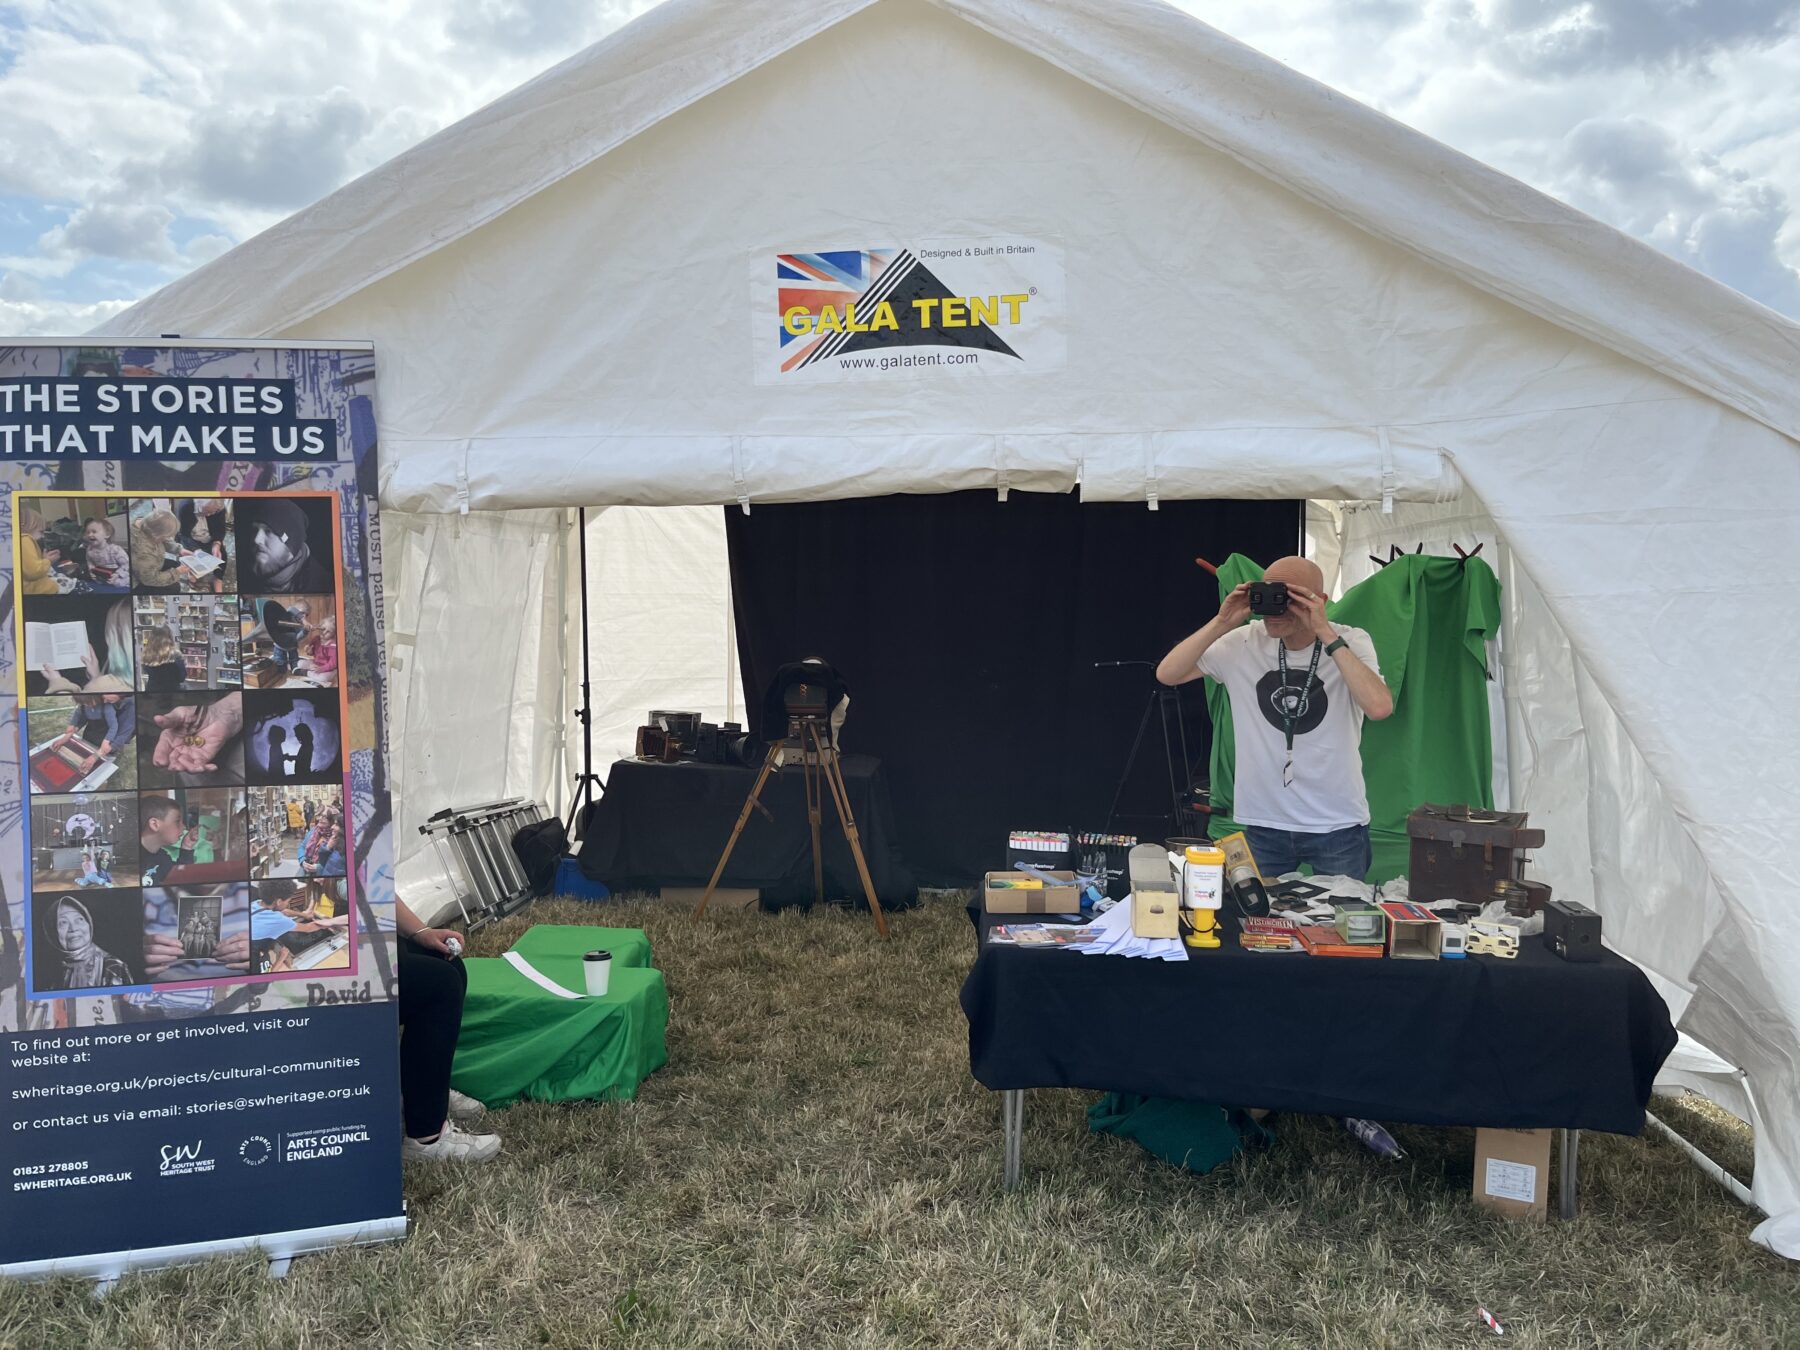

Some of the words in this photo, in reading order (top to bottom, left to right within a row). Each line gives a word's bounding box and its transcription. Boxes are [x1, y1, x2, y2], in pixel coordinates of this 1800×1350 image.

[920, 249, 962, 259] Designed
[964, 248, 972, 256] &
[974, 247, 994, 256] Built
[996, 246, 1004, 254] in
[1006, 245, 1035, 254] Britain
[783, 300, 900, 336] GALA
[840, 353, 978, 370] www.galatent.com
[0, 384, 81, 413] THE
[96, 384, 284, 415] STORIES
[0, 424, 114, 454] THAT
[131, 425, 256, 454] MAKE
[272, 426, 325, 455] US
[368, 572, 385, 630] pause
[306, 980, 372, 1007] David
[11, 1040, 28, 1052] To
[33, 1038, 61, 1050] find
[65, 1036, 90, 1048] out
[95, 1033, 132, 1046] more
[136, 1032, 152, 1042] or
[156, 1028, 181, 1044] get
[185, 1022, 249, 1038] involved,
[253, 1018, 283, 1031] visit
[286, 1016, 310, 1029] our
[11, 1052, 68, 1068] website
[72, 1052, 91, 1063] at:
[12, 1056, 361, 1100] swheritage.org.uk/projects/cultural-communities
[12, 1120, 28, 1132] or
[33, 1113, 89, 1130] contact
[93, 1112, 110, 1124] us
[114, 1109, 135, 1122] via
[138, 1104, 182, 1120] email:
[186, 1084, 371, 1115] stories@swheritage.org.uk
[239, 1140, 250, 1156] ARTS
[250, 1135, 272, 1152] COUNCIL
[287, 1137, 318, 1150] ARTS
[320, 1131, 371, 1145] COUNCIL
[171, 1161, 195, 1170] SOUTH
[195, 1158, 216, 1167] WEST
[243, 1154, 269, 1166] ENGLAND
[286, 1146, 343, 1162] ENGLAND
[13, 1164, 46, 1177] 01823
[48, 1161, 89, 1173] 278805
[160, 1167, 193, 1177] HERITAGE
[194, 1164, 216, 1174] TRUST
[14, 1172, 133, 1192] SWHERITAGE.ORG.UK
